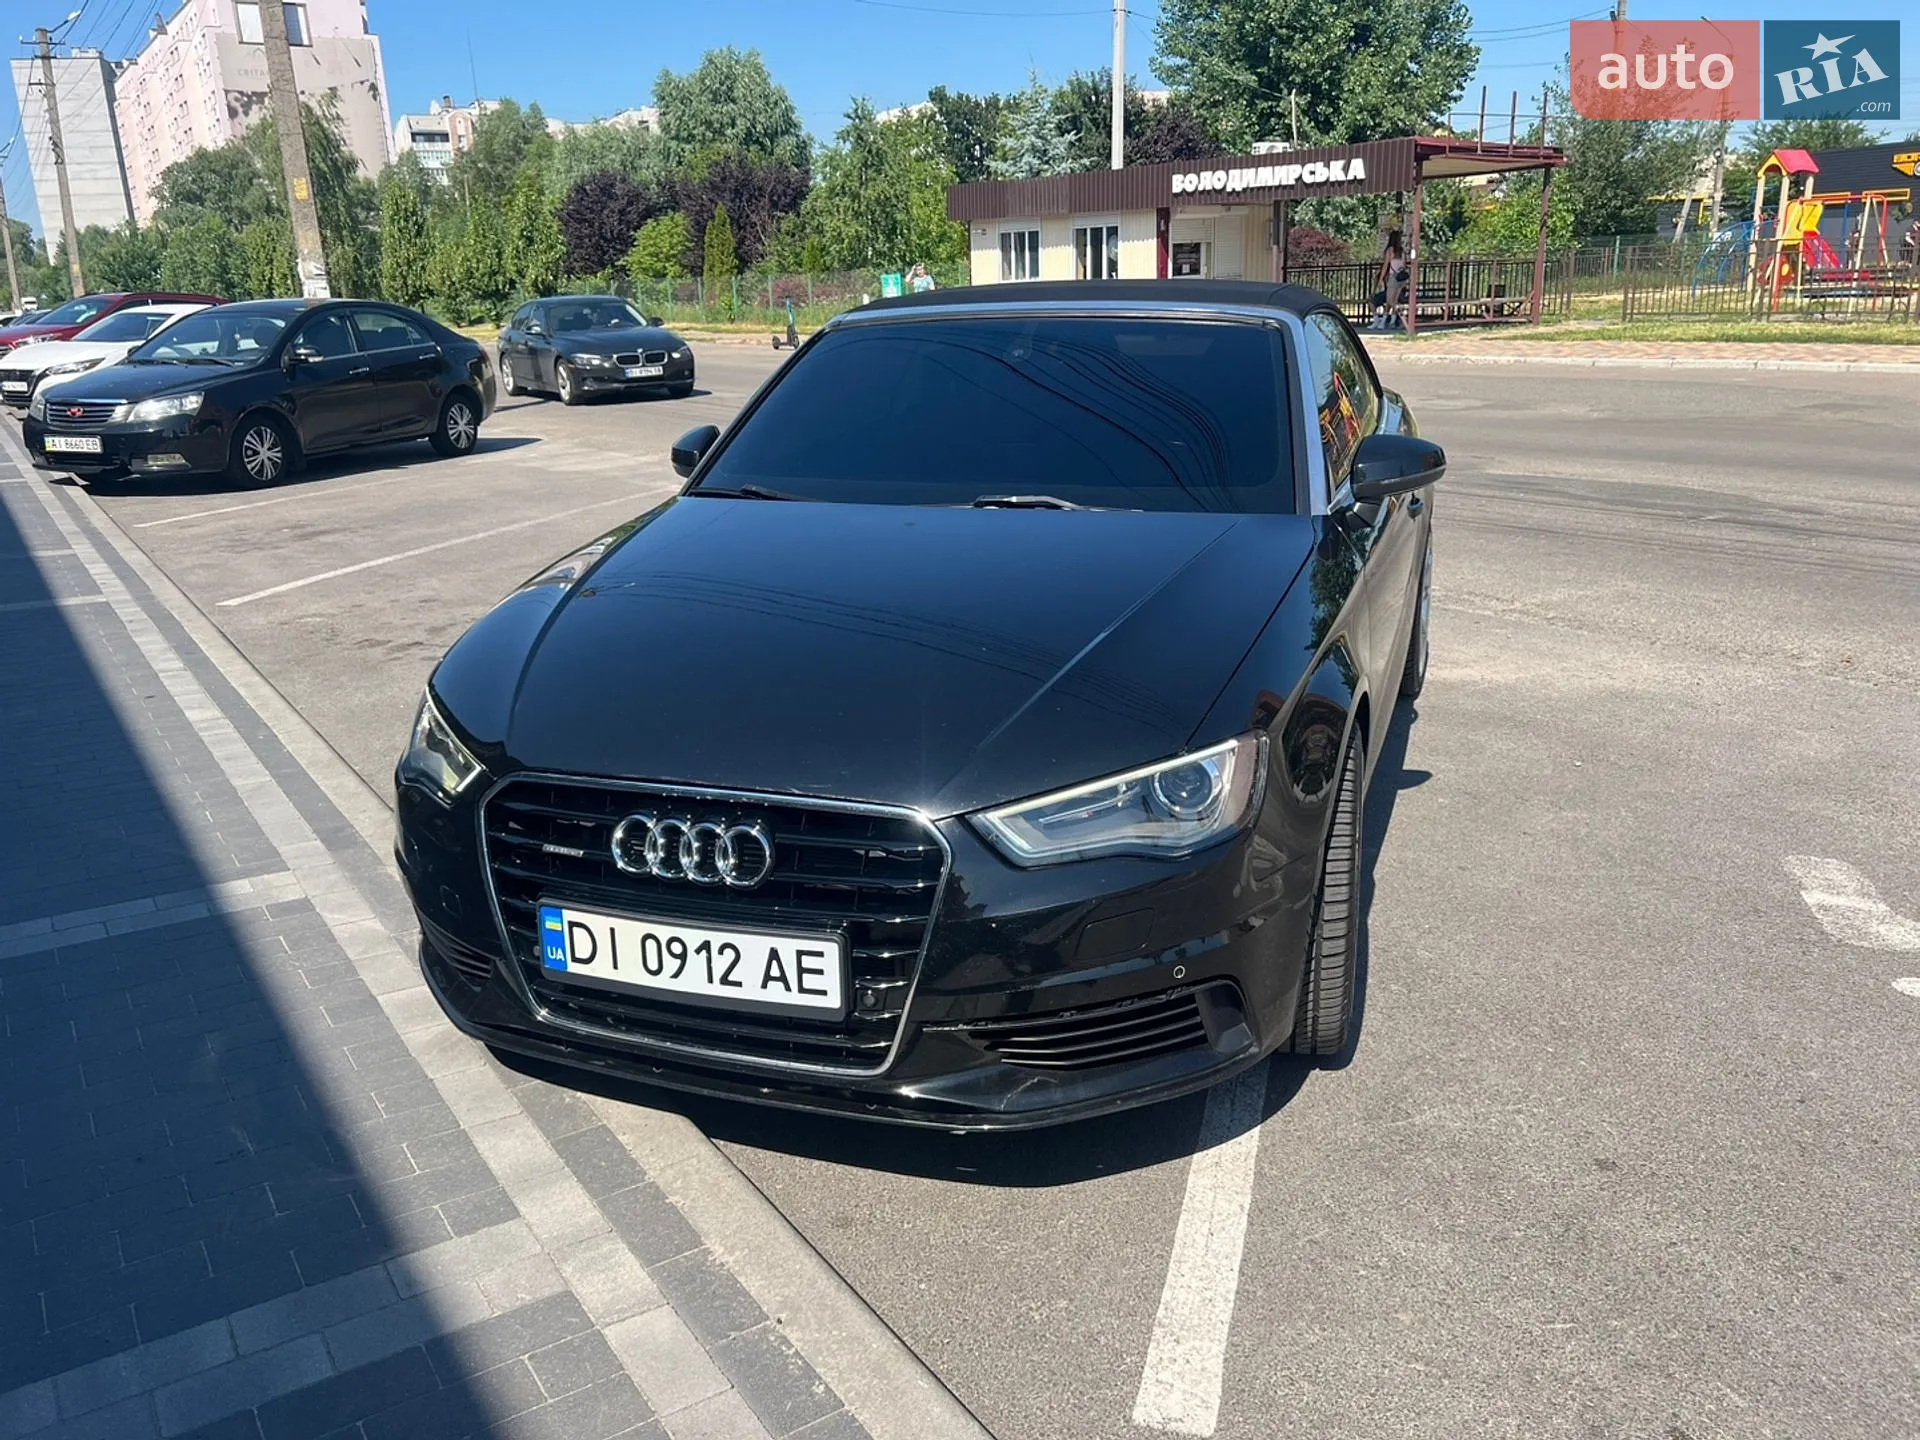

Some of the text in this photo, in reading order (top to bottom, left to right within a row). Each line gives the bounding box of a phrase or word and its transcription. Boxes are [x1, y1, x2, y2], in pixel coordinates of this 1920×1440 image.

[1172, 158, 1366, 193] ВОЛОДИМИРСЬКА
[547, 945, 565, 961] UA
[567, 920, 828, 996] DI 0912 AE
